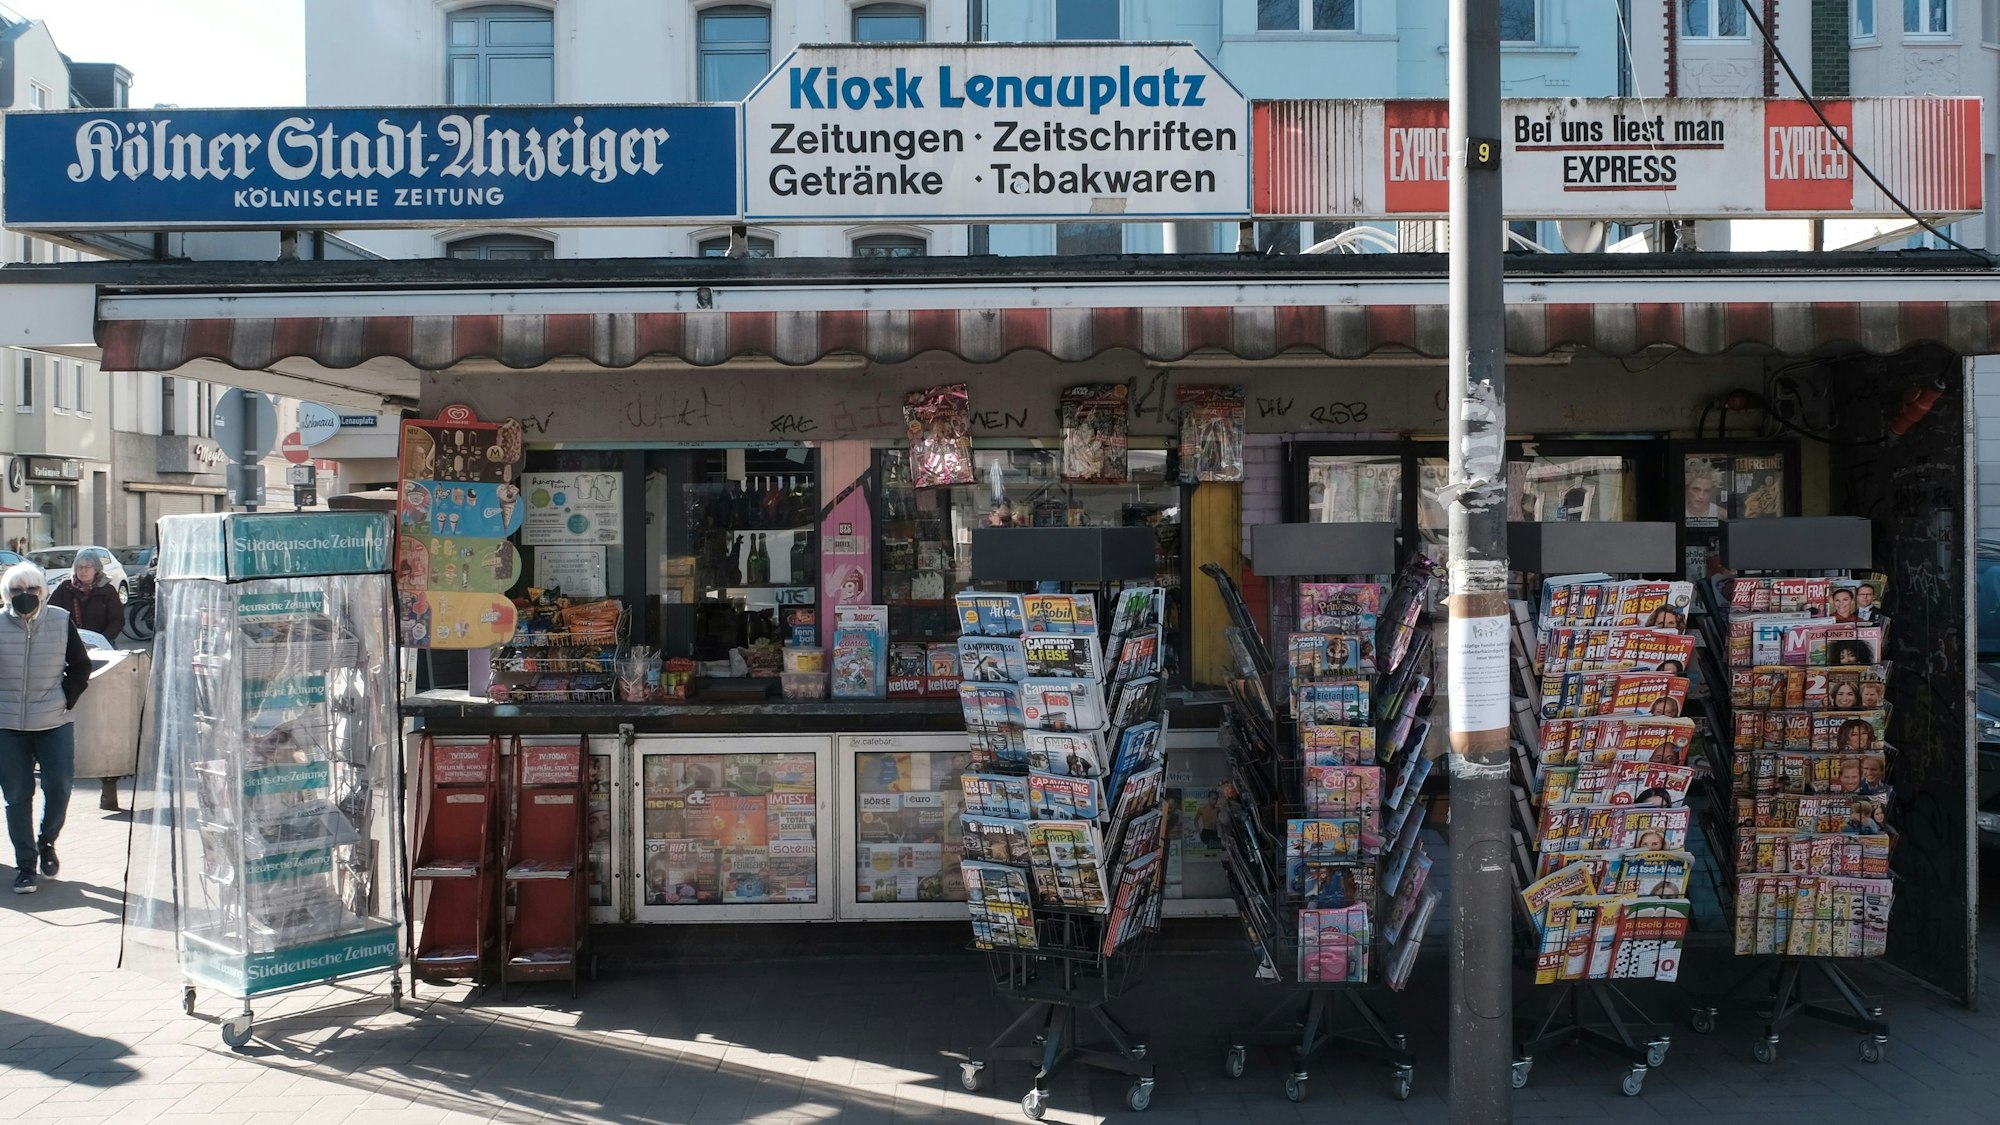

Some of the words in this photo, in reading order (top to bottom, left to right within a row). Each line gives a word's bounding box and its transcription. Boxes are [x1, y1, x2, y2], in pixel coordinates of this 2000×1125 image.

[789, 66, 926, 111] Kiosk
[939, 65, 1206, 115] Lenauplatz
[770, 123, 964, 160] Zeitungen
[993, 120, 1236, 152] Zeitschriften
[1515, 115, 1552, 143] Bei
[1561, 121, 1603, 143] uns
[1612, 114, 1664, 143] liest
[1674, 120, 1724, 143] man
[67, 117, 263, 182] Kölner
[266, 113, 671, 184] Stadt-Anzeiger
[1390, 126, 1450, 182] EXPRE
[1478, 142, 1490, 163] 9
[1770, 125, 1848, 181] EXPRESS
[769, 165, 943, 196] Getränke
[990, 163, 1215, 194] Tabakwaren
[1564, 154, 1677, 184] EXPRESS
[234, 187, 378, 208] KÖLNISCHE
[394, 186, 505, 207] ZEITUNG
[341, 416, 375, 427] Lenauplatz
[235, 536, 329, 553] Süddeutsche
[330, 534, 383, 551] Zeitung
[776, 588, 808, 603] UTE
[1773, 582, 1805, 595] tina
[247, 952, 343, 981] Süddeutsche
[342, 941, 396, 963] Zeitung
